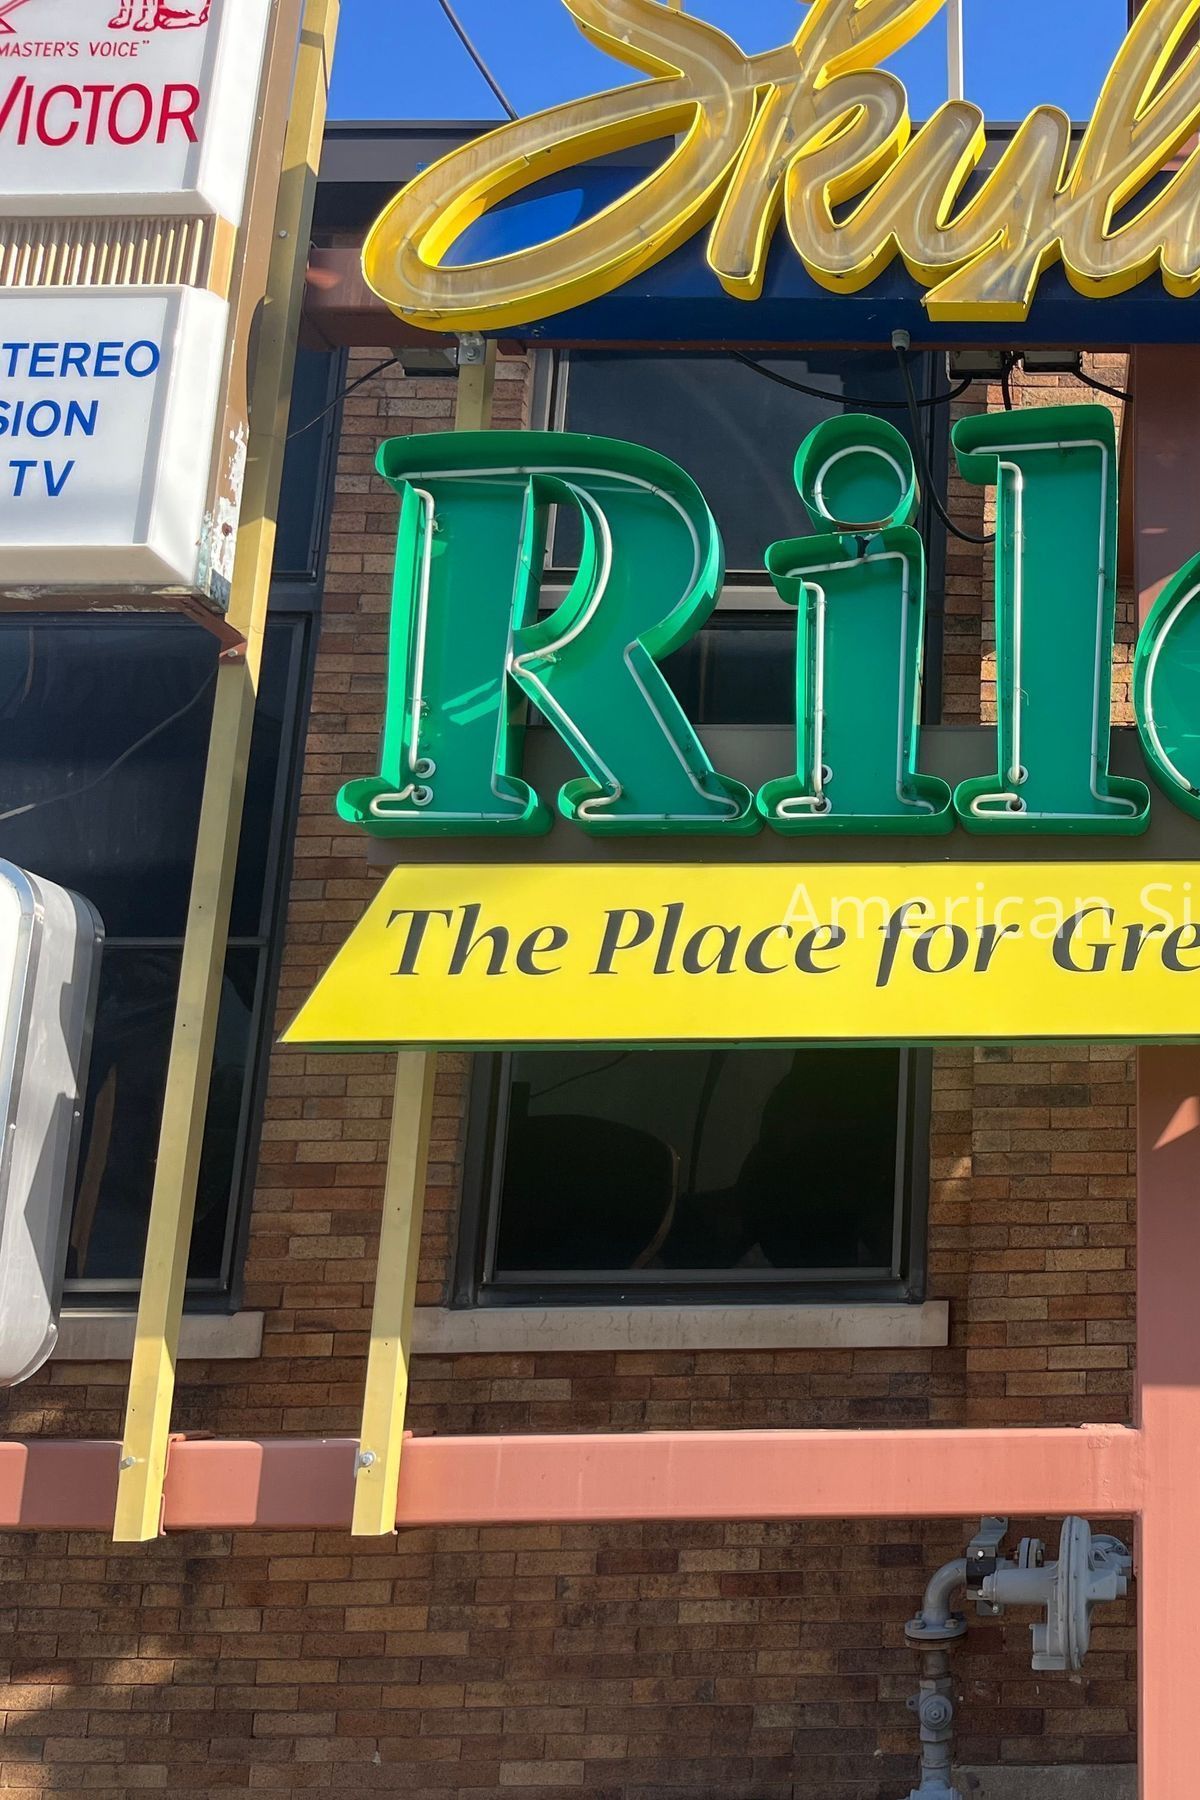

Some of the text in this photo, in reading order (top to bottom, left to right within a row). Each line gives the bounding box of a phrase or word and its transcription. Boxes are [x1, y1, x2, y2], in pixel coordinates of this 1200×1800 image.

[2, 340, 160, 378] TEREO
[9, 460, 75, 497] TV
[386, 902, 568, 976] The
[589, 902, 846, 975] Place
[874, 900, 1019, 987] for
